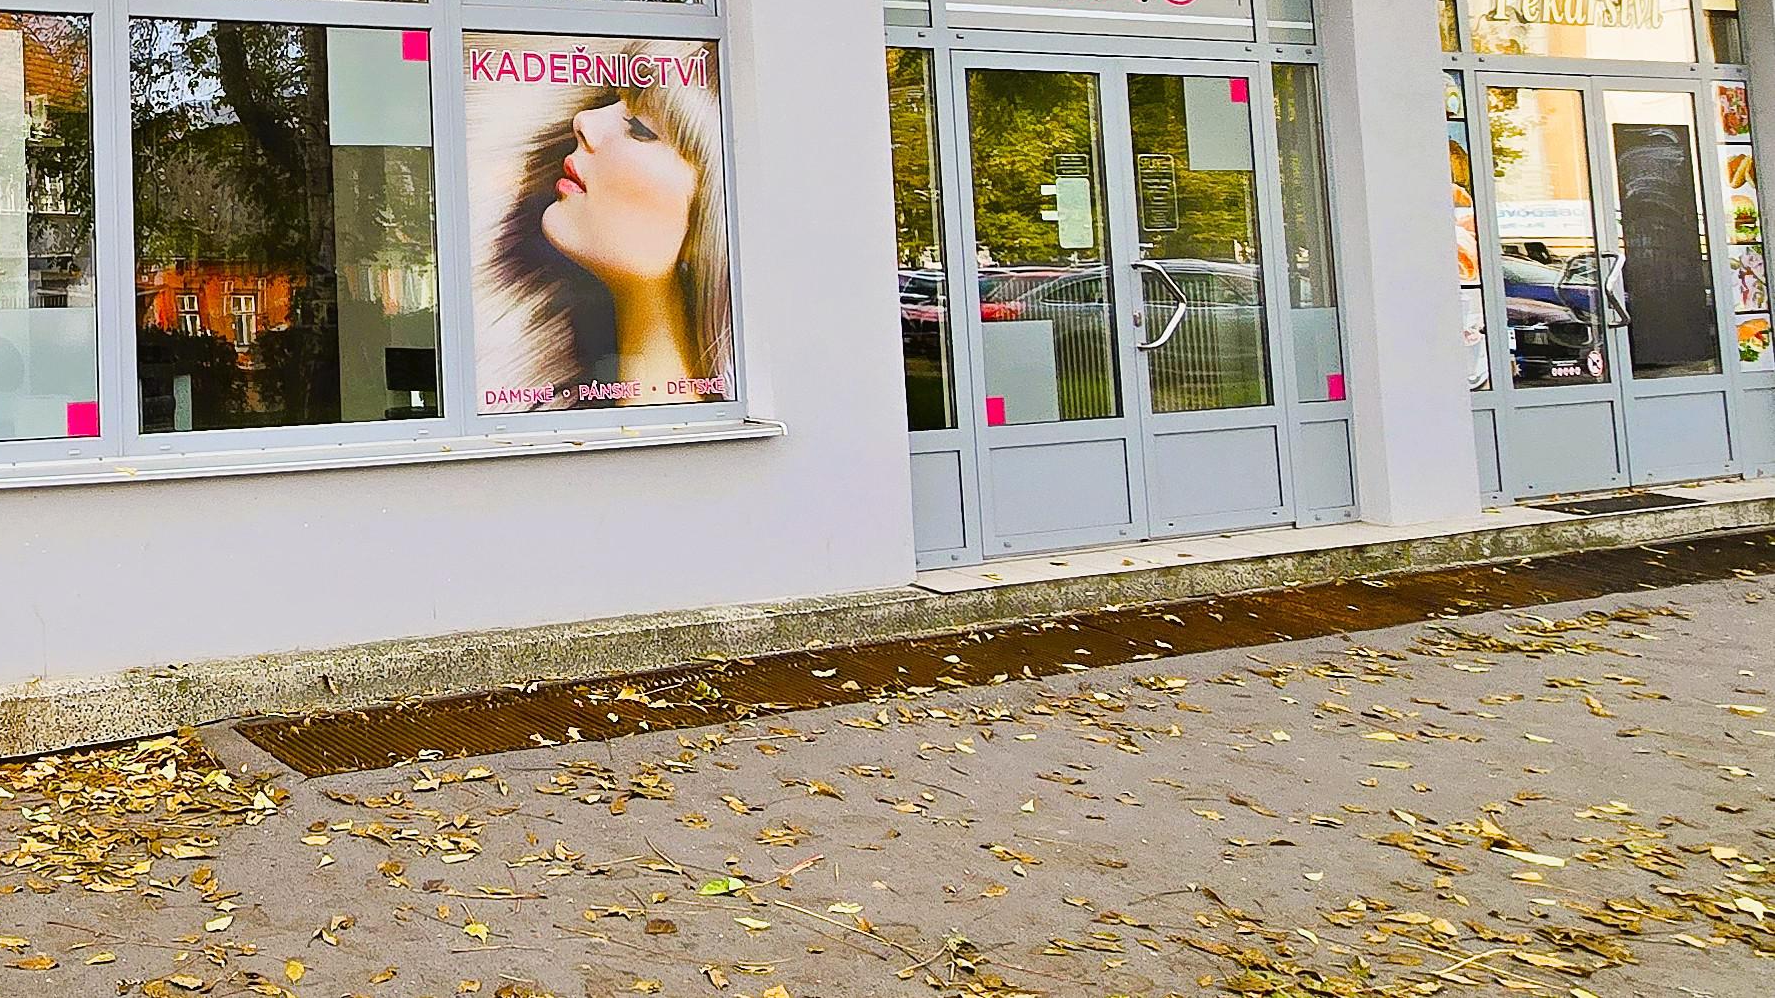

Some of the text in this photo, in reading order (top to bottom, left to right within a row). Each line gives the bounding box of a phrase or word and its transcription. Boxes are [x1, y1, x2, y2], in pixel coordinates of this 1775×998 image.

[469, 45, 710, 89] KADEŘNICTVÍ
[485, 382, 554, 405] DÁMSKÉ
[579, 379, 642, 400] PÁNSKÉ
